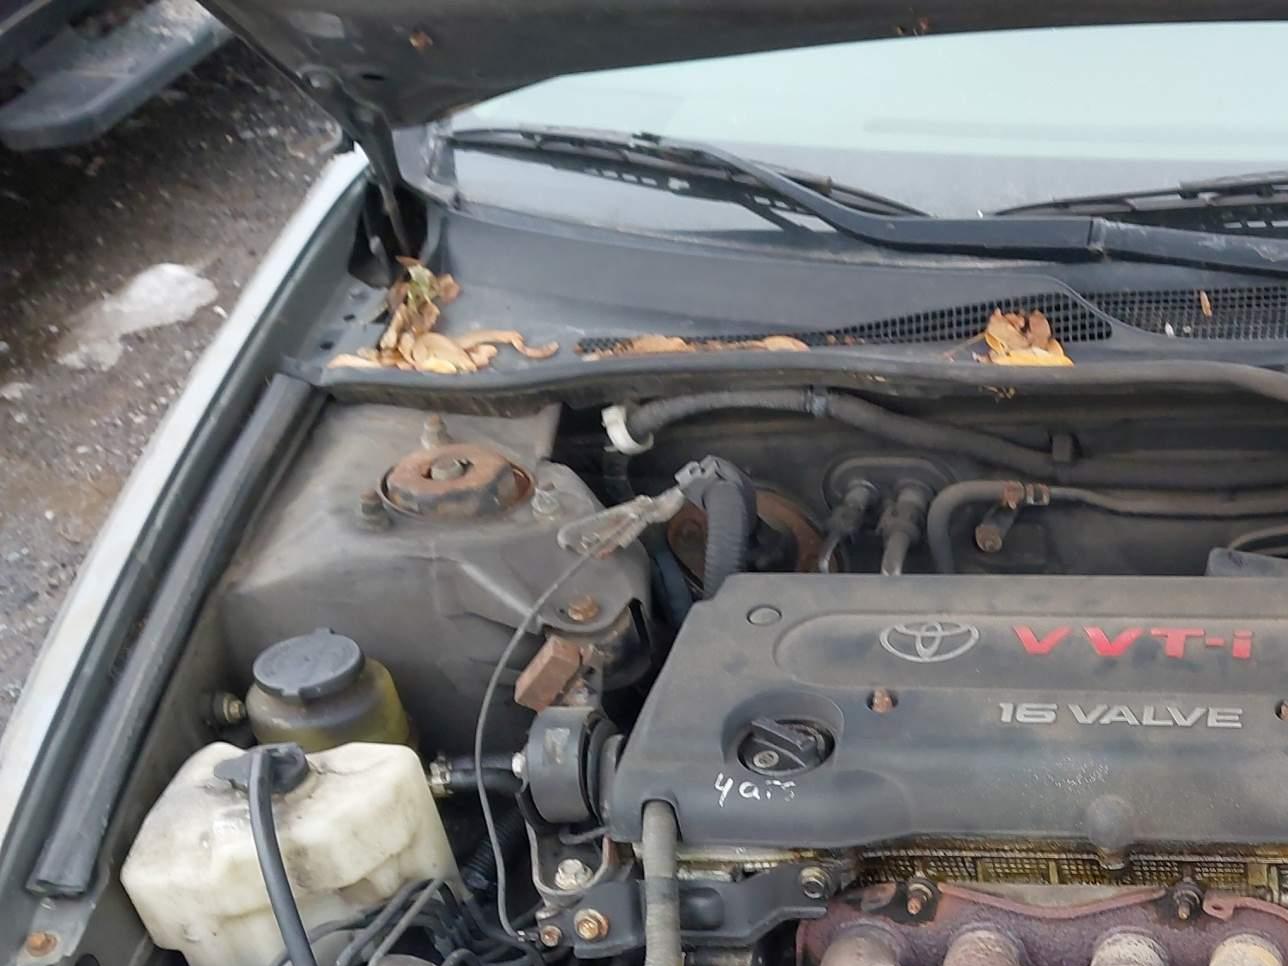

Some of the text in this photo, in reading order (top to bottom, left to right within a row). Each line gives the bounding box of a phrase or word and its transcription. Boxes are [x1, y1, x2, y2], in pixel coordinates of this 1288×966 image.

[1012, 625, 1254, 660] VVT-i
[999, 701, 1244, 729] 16 VALVE
